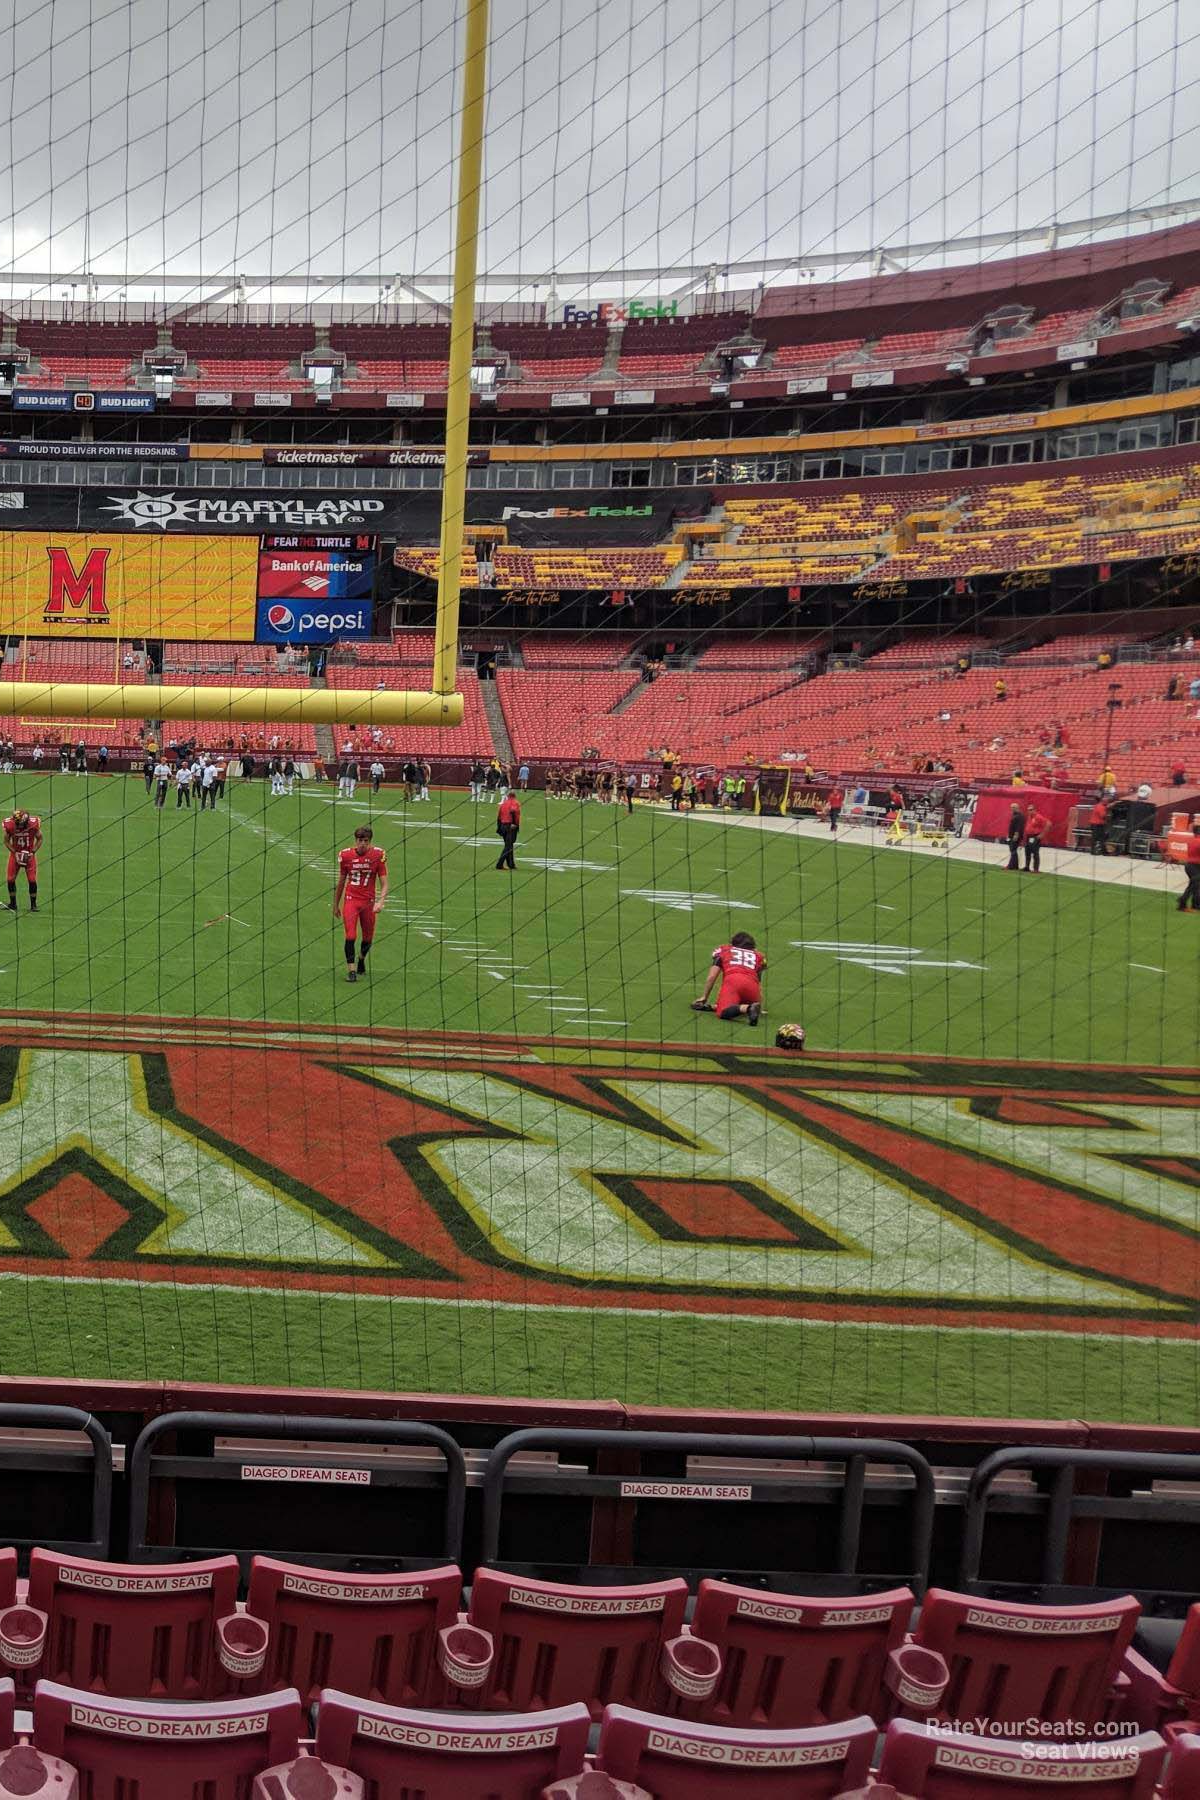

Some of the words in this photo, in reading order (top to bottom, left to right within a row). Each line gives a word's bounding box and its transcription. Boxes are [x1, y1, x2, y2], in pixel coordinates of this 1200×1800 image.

[19, 396, 38, 405] BUD
[39, 397, 67, 406] LIGHT
[101, 398, 120, 407] BUD
[121, 398, 150, 407] LIGHT
[19, 446, 48, 455] PROUD
[49, 446, 61, 455] TO
[62, 446, 96, 455] DELIVER
[99, 447, 115, 455] FOR
[116, 447, 132, 456] THE
[277, 450, 359, 464] ticketmaster
[390, 450, 476, 464] ticketmar
[200, 499, 385, 513] MARYLAND
[502, 506, 653, 520] FedExField
[272, 559, 299, 572] Bank
[300, 559, 314, 572] of
[315, 560, 362, 573] America
[45, 546, 111, 614] M
[299, 610, 363, 633] pepsi
[730, 947, 757, 969] 38
[243, 1468, 287, 1479] DIAGEO
[291, 1469, 331, 1480] DREAM
[335, 1472, 368, 1482] SEATS
[623, 1485, 667, 1495] DIAGEO
[671, 1486, 712, 1496] DREAM
[716, 1487, 748, 1497] SEATS
[60, 1569, 113, 1586] DIAGEO
[117, 1579, 167, 1590] DREAM
[172, 1575, 209, 1588] SEATS
[285, 1577, 339, 1593] DIAGEO
[344, 1586, 393, 1597] DREAM
[398, 1585, 429, 1597] SEA
[512, 1589, 567, 1607] DIAGEO
[572, 1598, 617, 1610] DREAM
[623, 1597, 662, 1610] SEATS
[739, 1601, 796, 1619] DIAGEO
[822, 1609, 851, 1621] EAM
[855, 1607, 890, 1619] SEATS
[970, 1609, 1027, 1628] DIAGEO
[1032, 1617, 1078, 1631] DREAM
[1083, 1615, 1119, 1630] SEATS
[74, 1708, 141, 1732] DIAGEO
[147, 1721, 212, 1734] DREAM
[220, 1715, 265, 1732] SEATS
[359, 1719, 428, 1743] DIAGEO
[434, 1732, 499, 1748] DREAM
[506, 1730, 551, 1747] SEATS
[650, 1732, 722, 1757] DIAGEO
[729, 1746, 794, 1762] DREAM
[800, 1744, 844, 1760] SEATS
[938, 1749, 1014, 1772] DIAGEO
[1020, 1761, 1086, 1777] DREAM
[1092, 1761, 1134, 1776] SEATS
